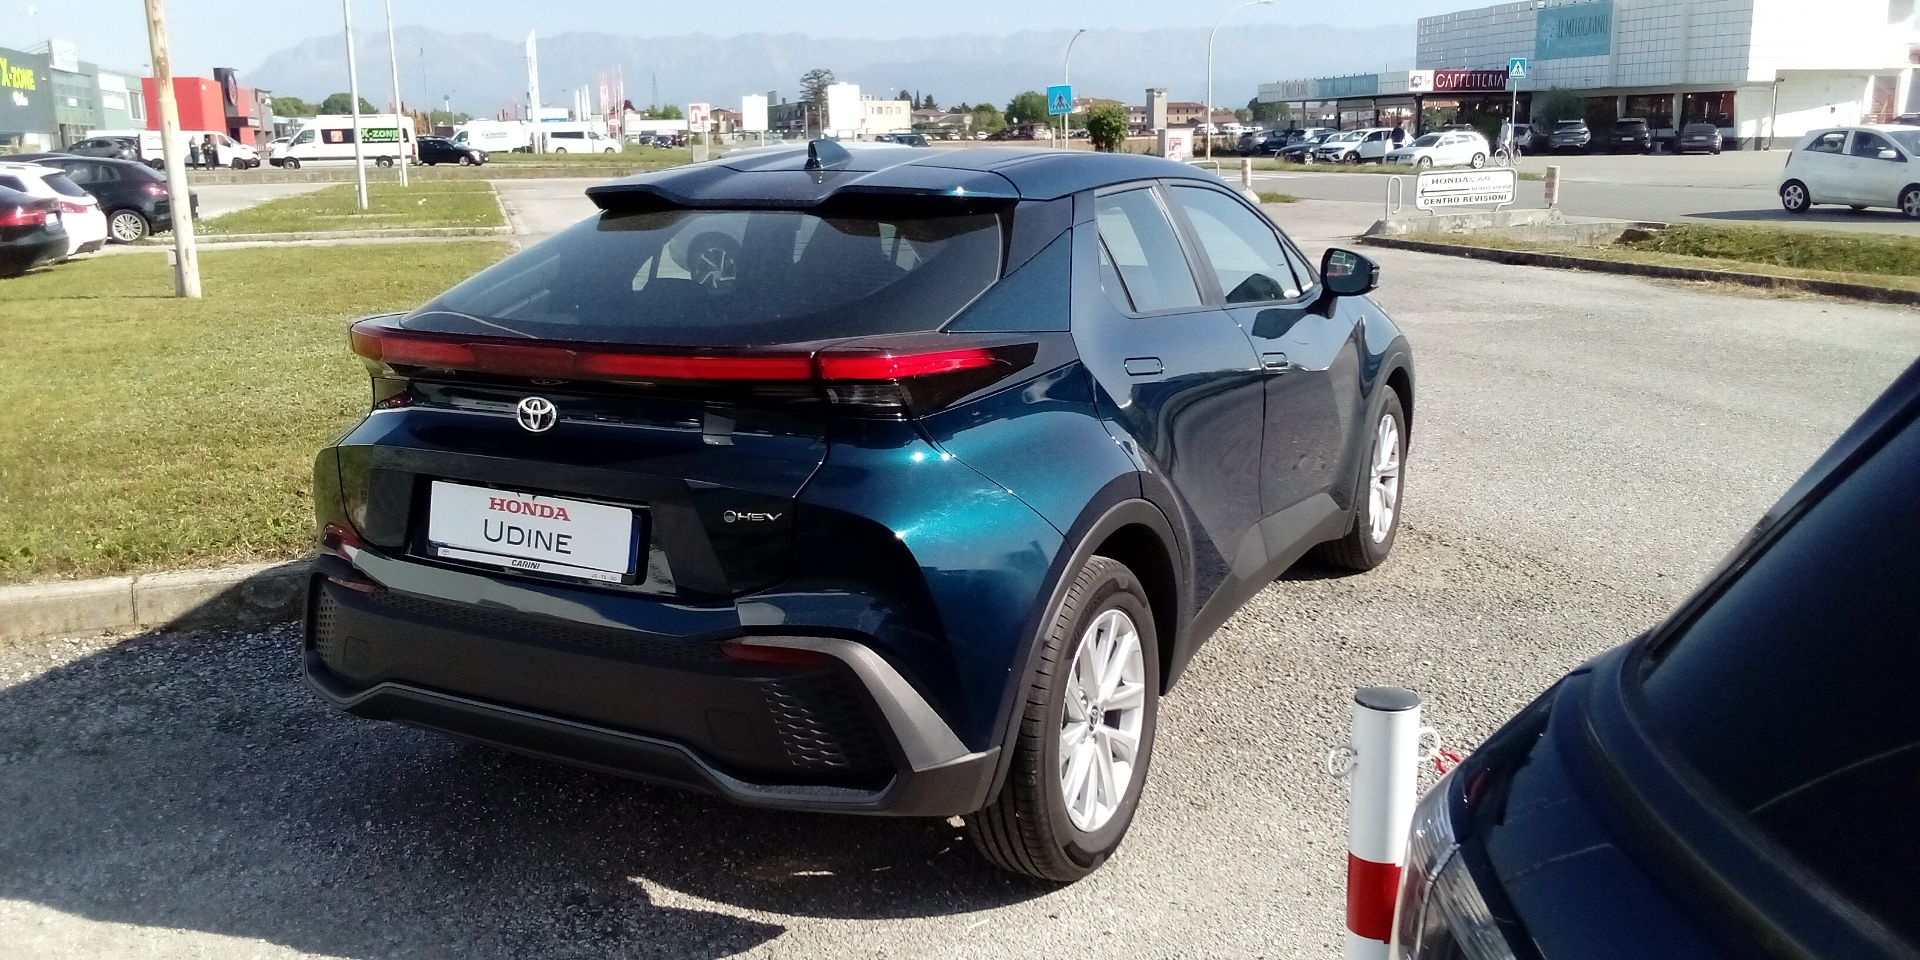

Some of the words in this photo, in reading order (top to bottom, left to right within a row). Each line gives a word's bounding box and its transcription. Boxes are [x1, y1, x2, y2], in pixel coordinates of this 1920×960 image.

[1566, 14, 1608, 37] MELOGRANO
[1435, 73, 1505, 88] CAFFETTERIA
[1423, 196, 1460, 205] CENTRO
[1463, 194, 1507, 203] REVISIONI
[489, 497, 571, 522] HONDA
[737, 512, 782, 521] HEV
[483, 518, 573, 555] UDINE
[511, 559, 541, 570] CARINI
